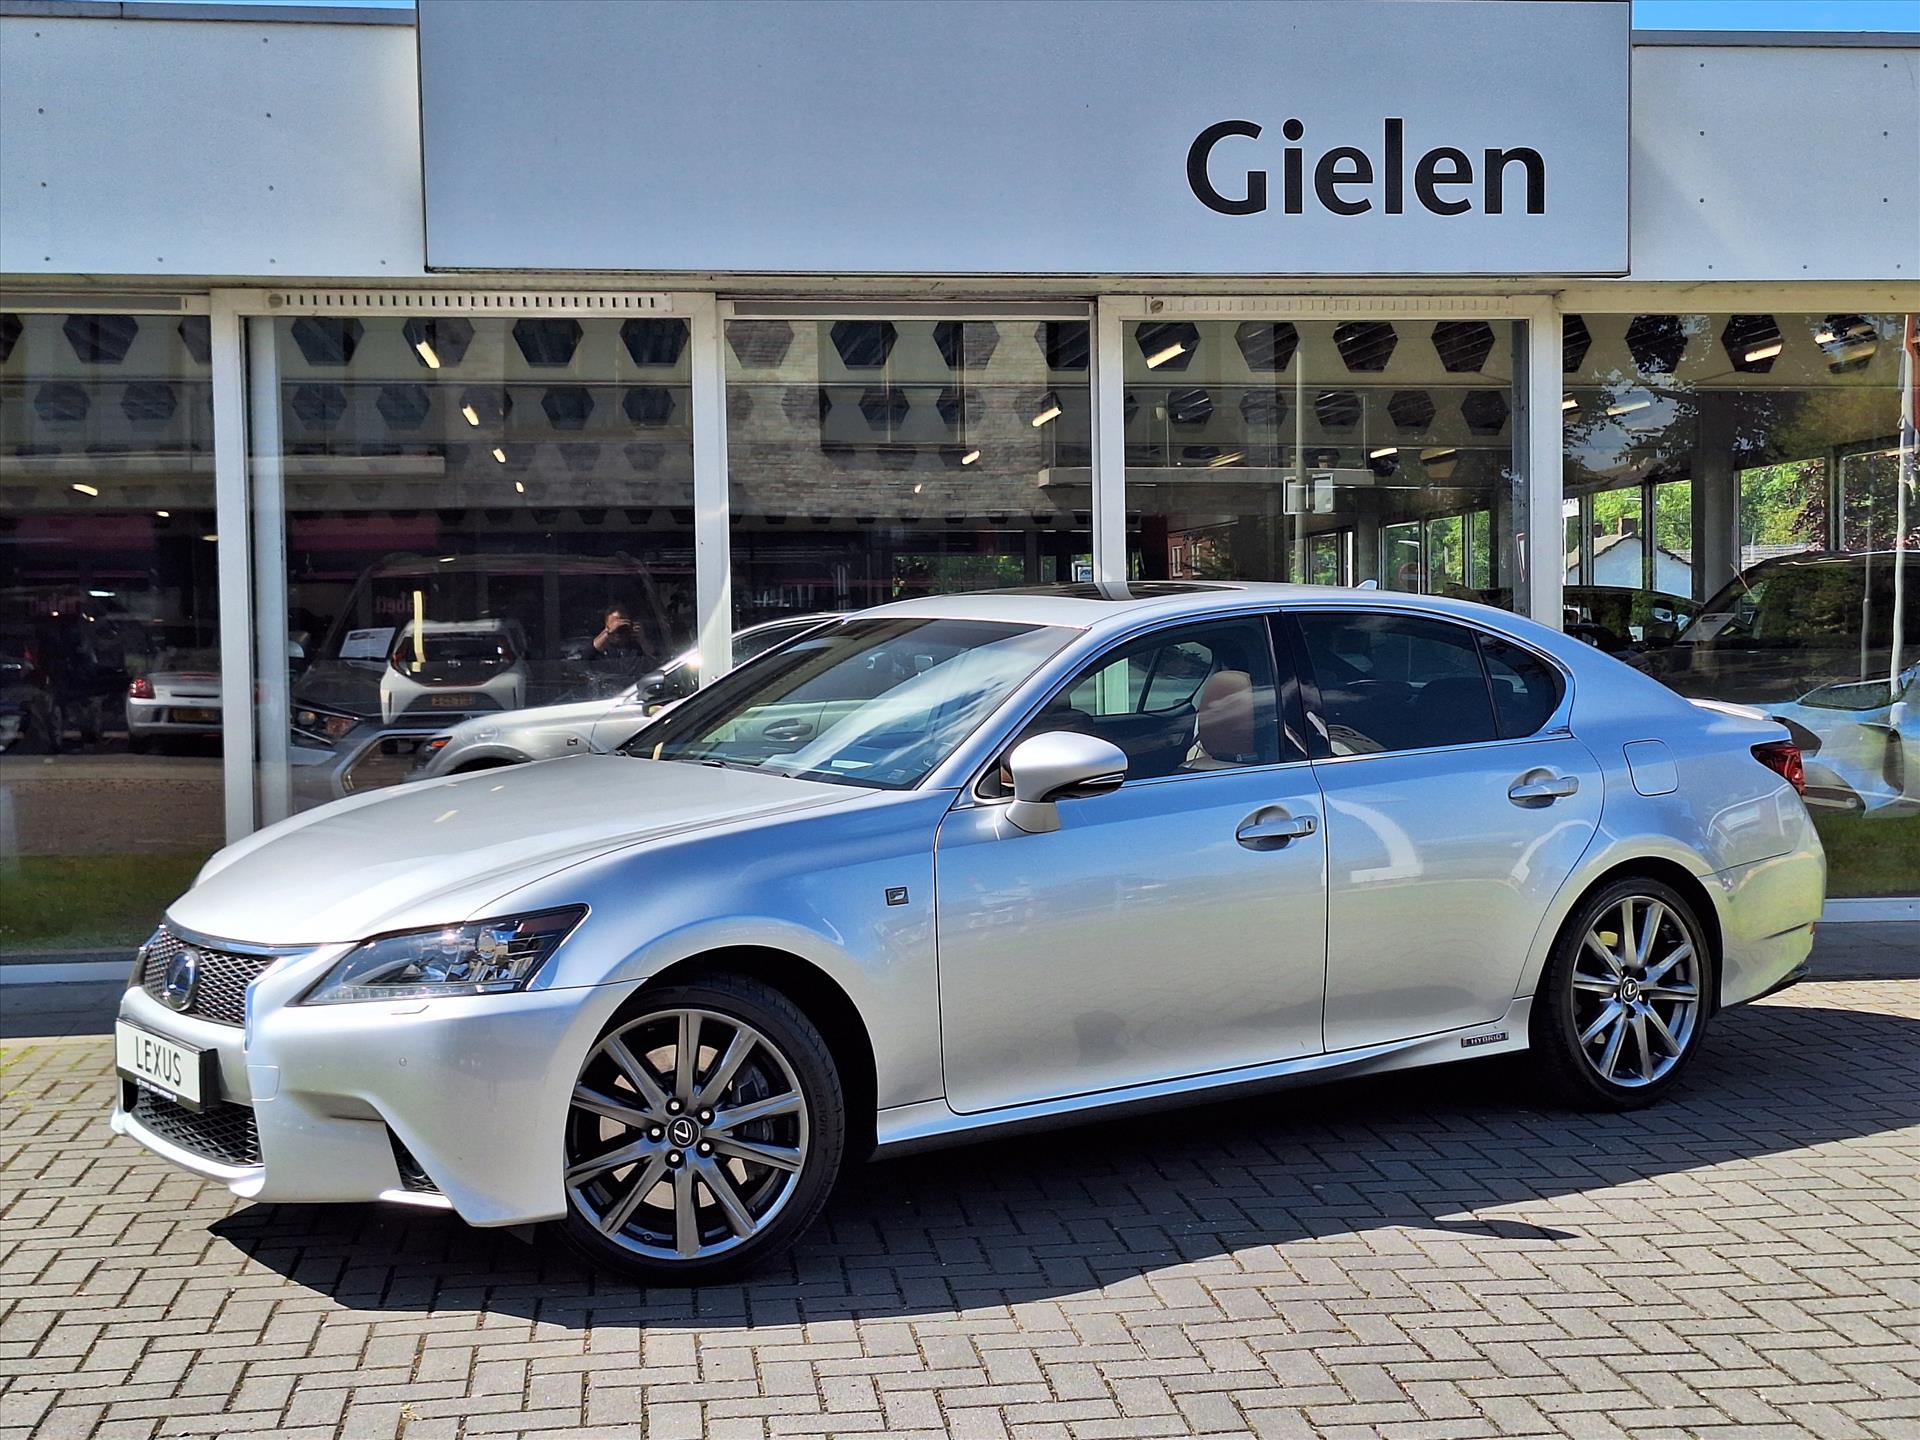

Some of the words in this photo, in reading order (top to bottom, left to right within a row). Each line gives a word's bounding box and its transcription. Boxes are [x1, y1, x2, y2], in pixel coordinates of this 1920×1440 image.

[1186, 117, 1545, 216] Gielen
[136, 1036, 181, 1087] LEXUS
[1469, 1033, 1504, 1045] HYBRID
